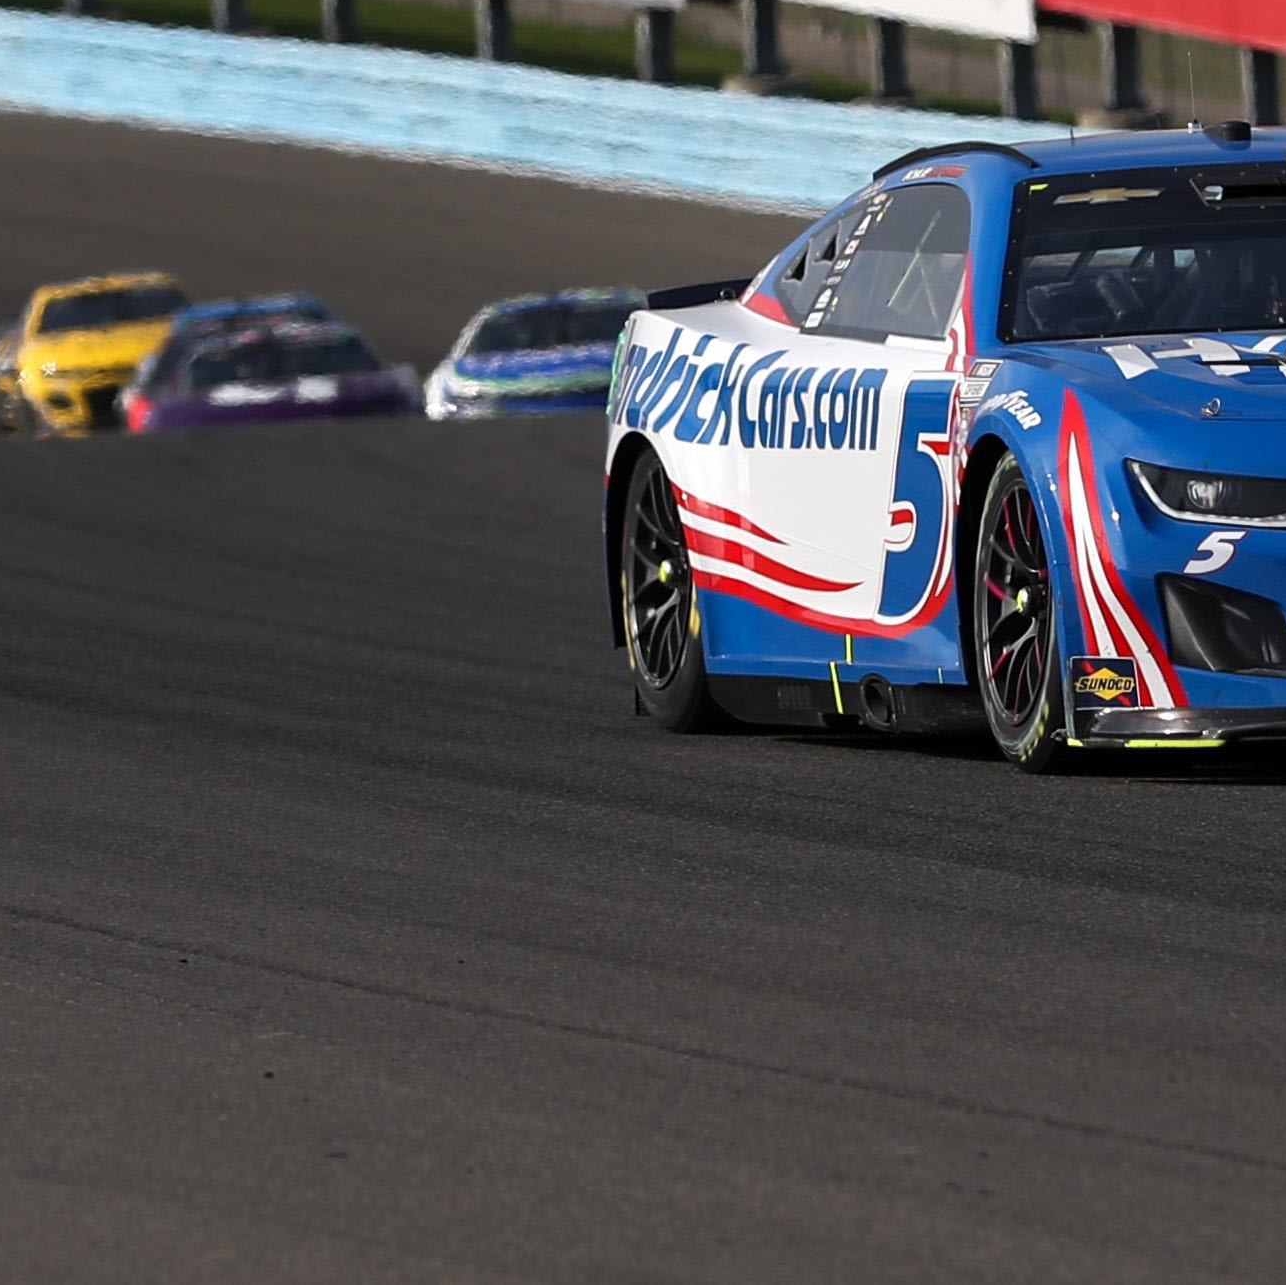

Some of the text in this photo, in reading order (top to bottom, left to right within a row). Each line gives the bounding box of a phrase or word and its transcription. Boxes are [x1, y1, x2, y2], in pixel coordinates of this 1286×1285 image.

[874, 371, 957, 625] 5
[1182, 530, 1248, 575] 5
[1077, 677, 1133, 692] SUNOCO
